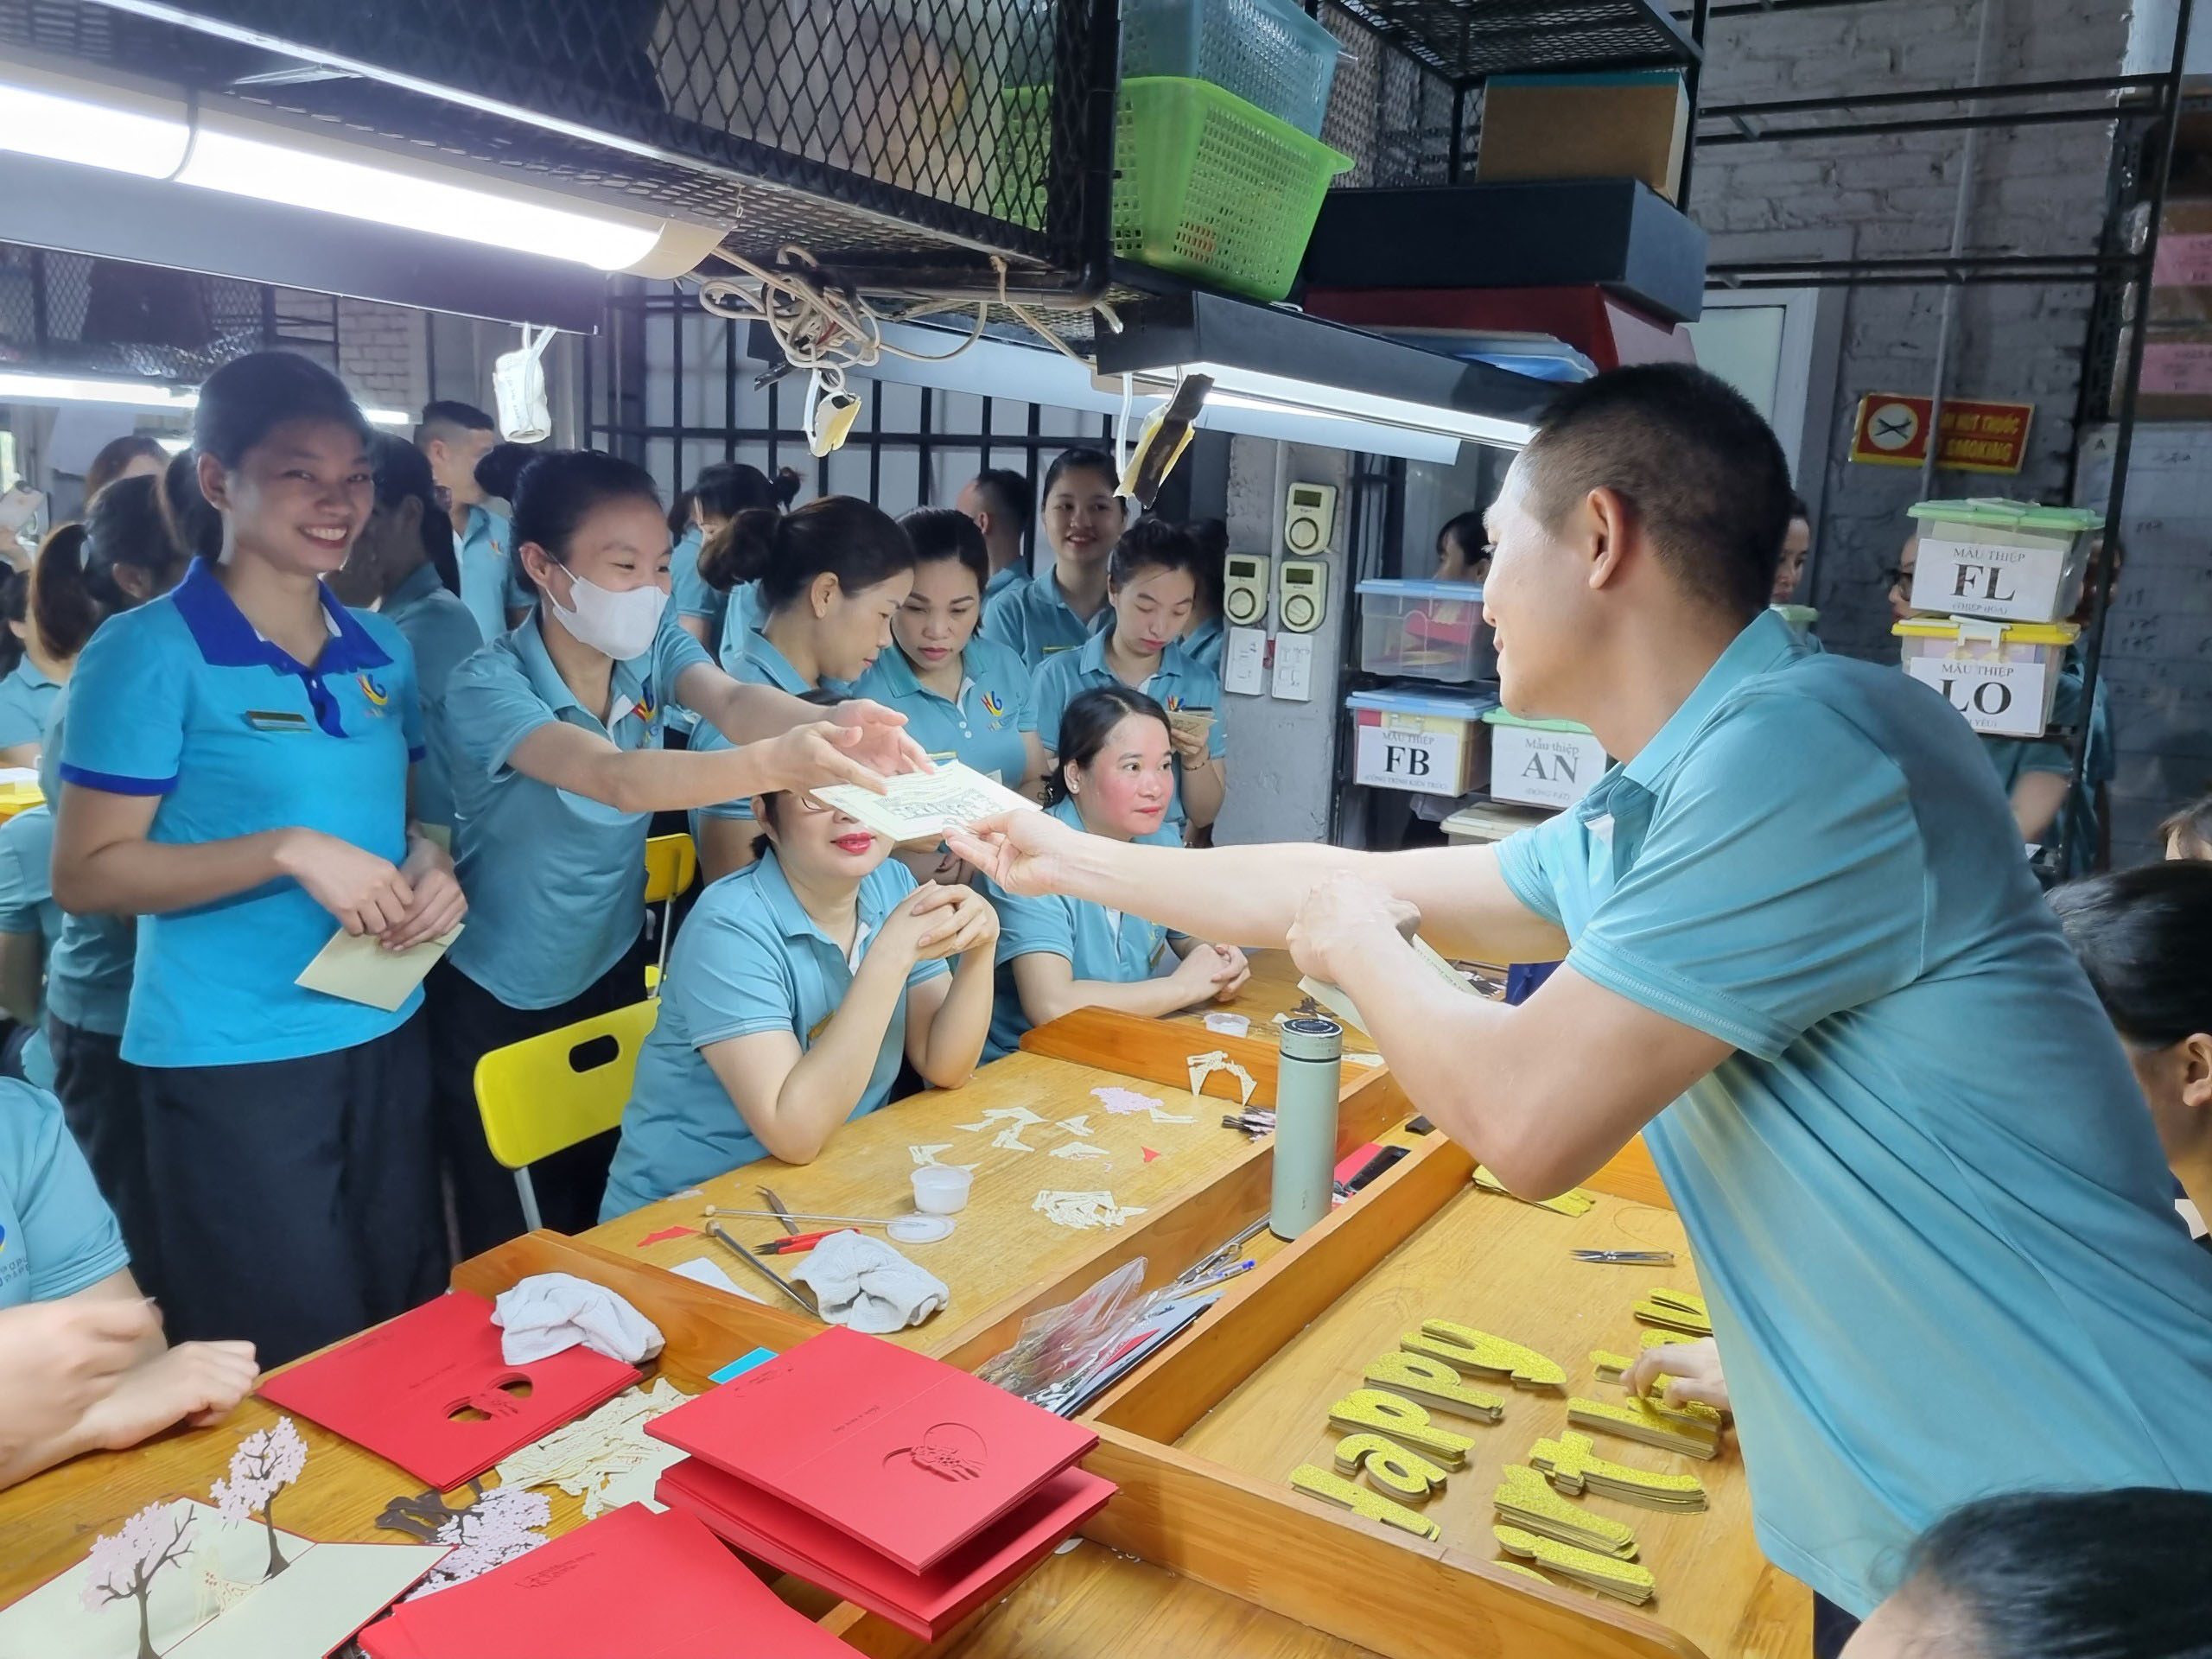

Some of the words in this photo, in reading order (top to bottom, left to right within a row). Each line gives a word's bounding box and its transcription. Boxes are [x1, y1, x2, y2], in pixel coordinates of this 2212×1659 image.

[1948, 563, 2018, 601] FL
[1938, 678, 2012, 715] LO
[1383, 744, 1430, 776] FB
[1521, 752, 1580, 784] AN
